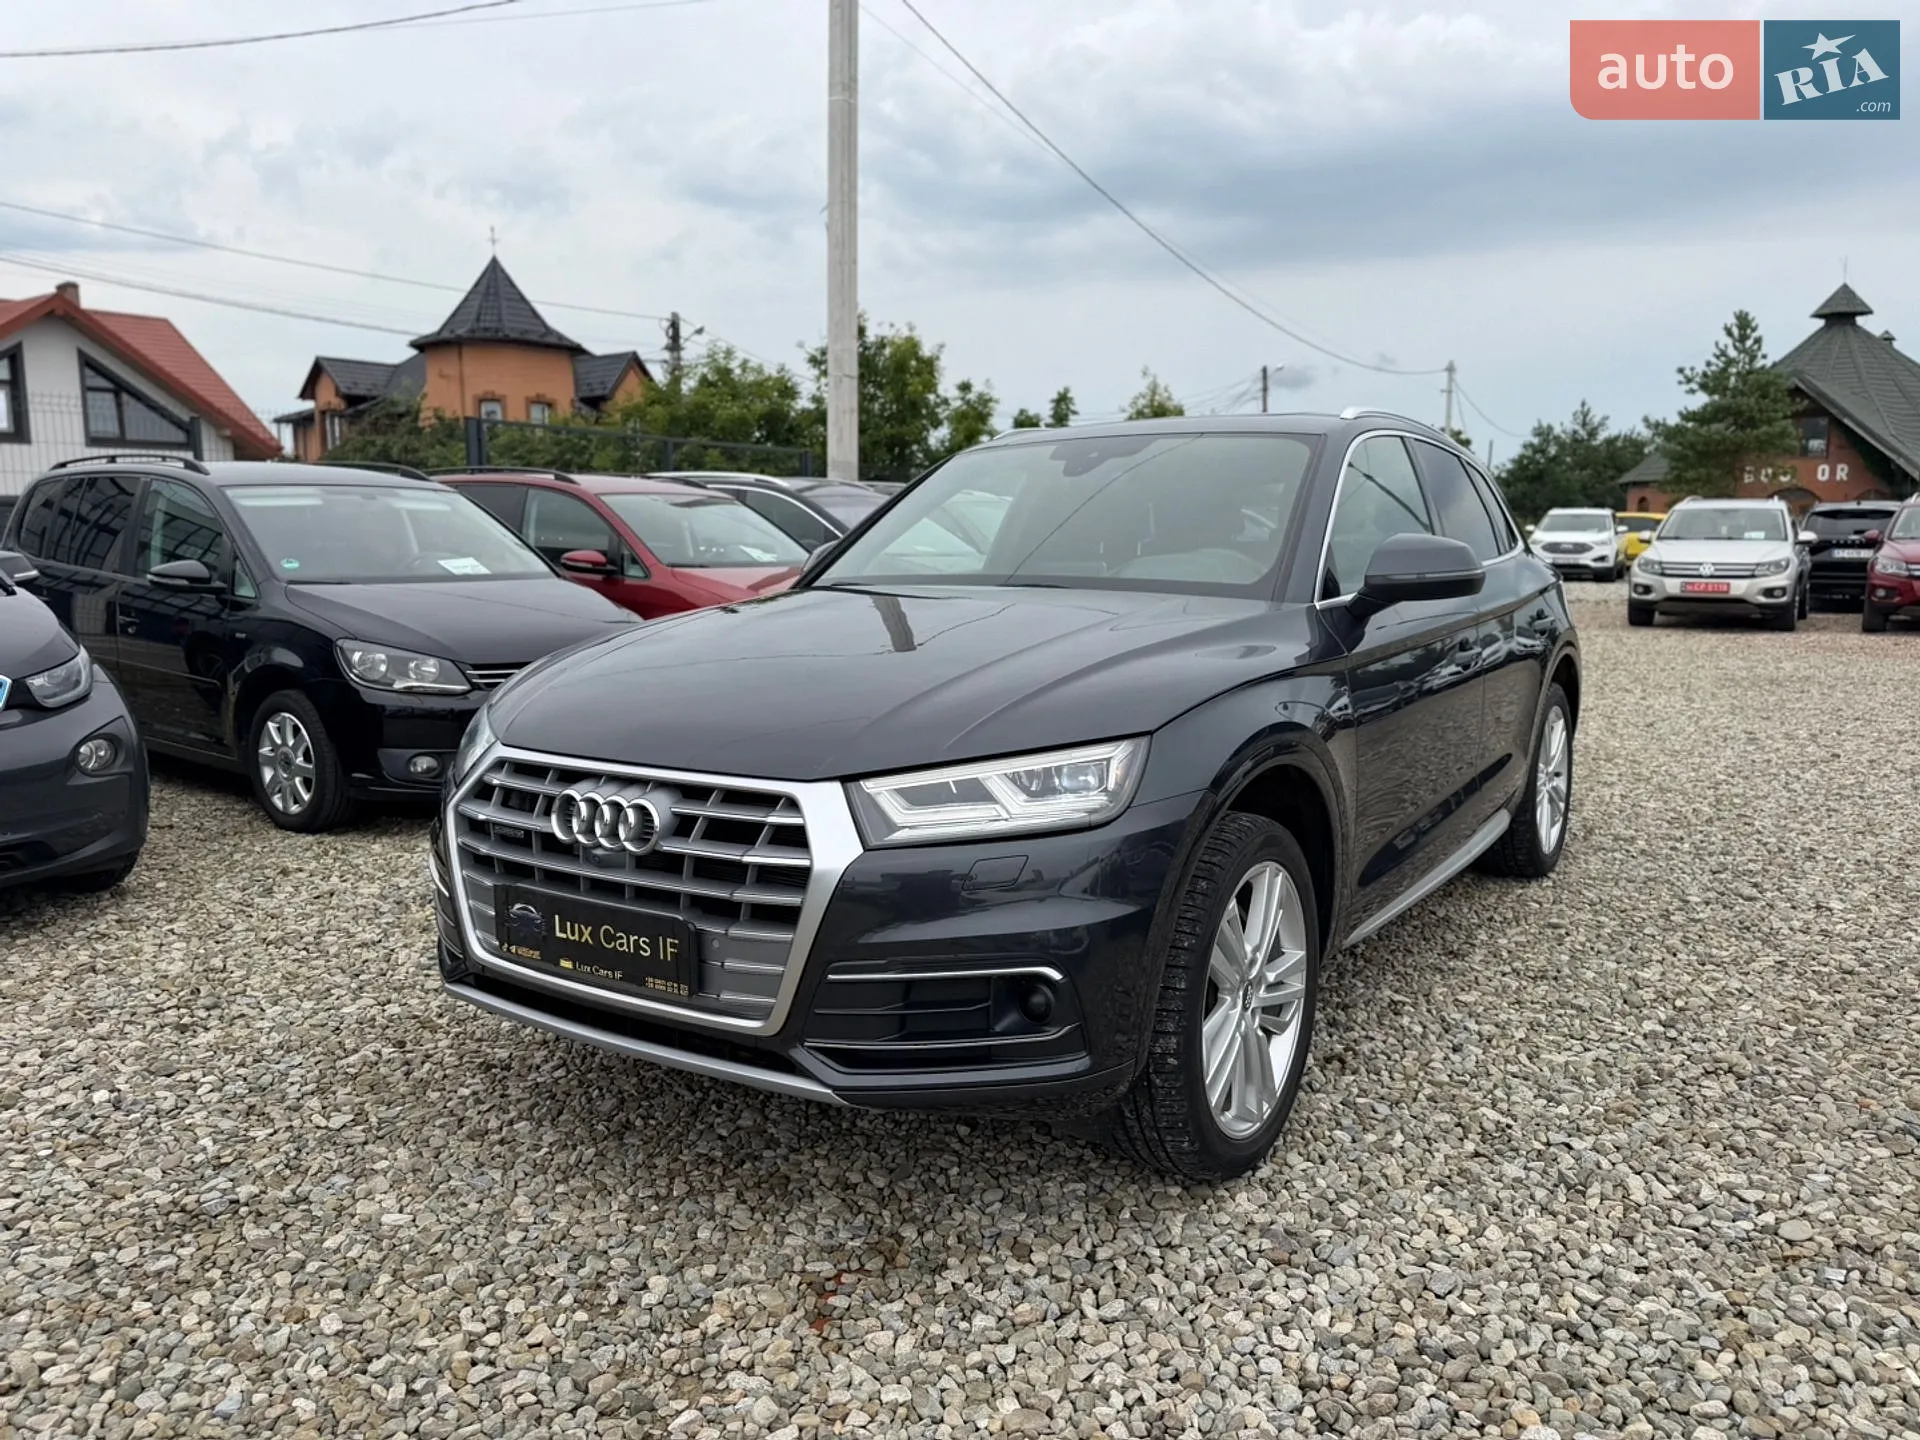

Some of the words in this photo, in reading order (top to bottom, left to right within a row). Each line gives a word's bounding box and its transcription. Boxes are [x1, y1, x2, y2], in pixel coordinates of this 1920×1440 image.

[554, 914, 594, 945] Lux
[600, 925, 651, 957] Cars
[659, 935, 680, 961] IF
[592, 965, 613, 979] Cars
